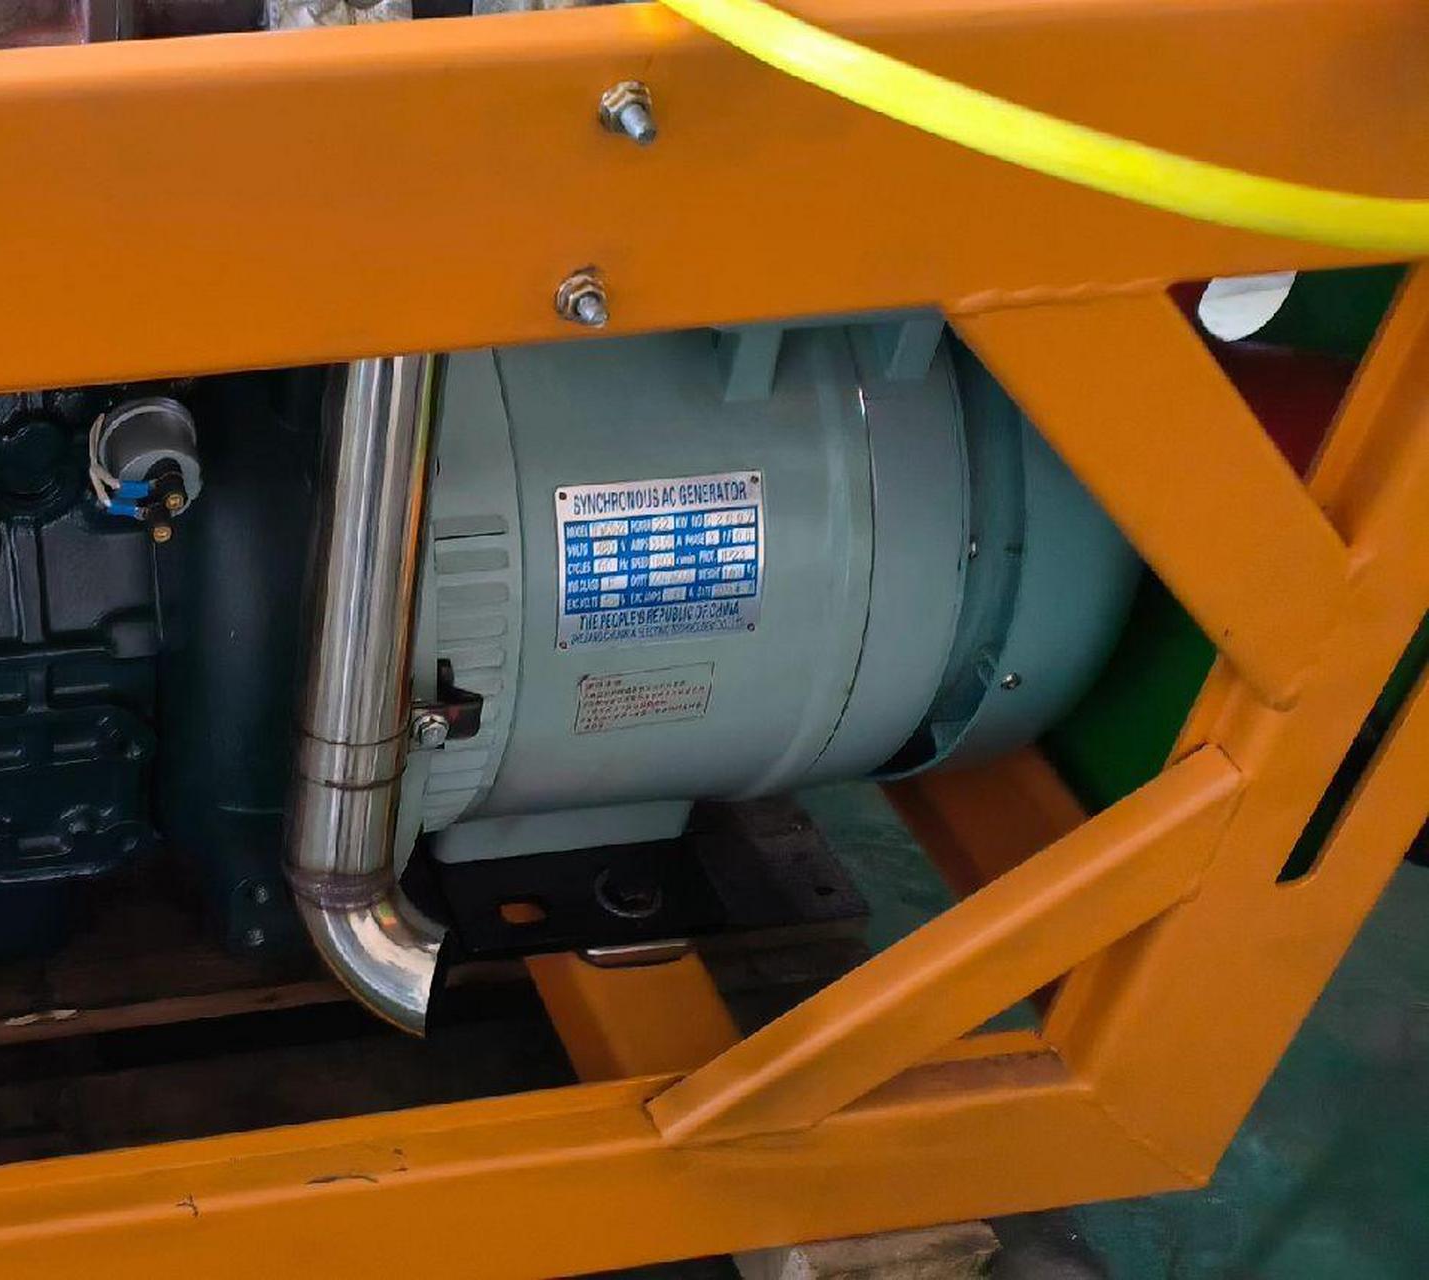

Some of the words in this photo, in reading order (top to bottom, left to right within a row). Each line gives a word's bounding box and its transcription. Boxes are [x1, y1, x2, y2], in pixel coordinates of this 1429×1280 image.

[573, 488, 660, 516] SYNCHRONOUS
[661, 488, 677, 508] AC
[679, 481, 748, 505] GENERATOR
[676, 534, 683, 547] A
[567, 561, 591, 575] CYCLES
[579, 614, 600, 630] THE
[647, 604, 695, 626] REPUBLIC
[710, 600, 741, 619] CHINA
